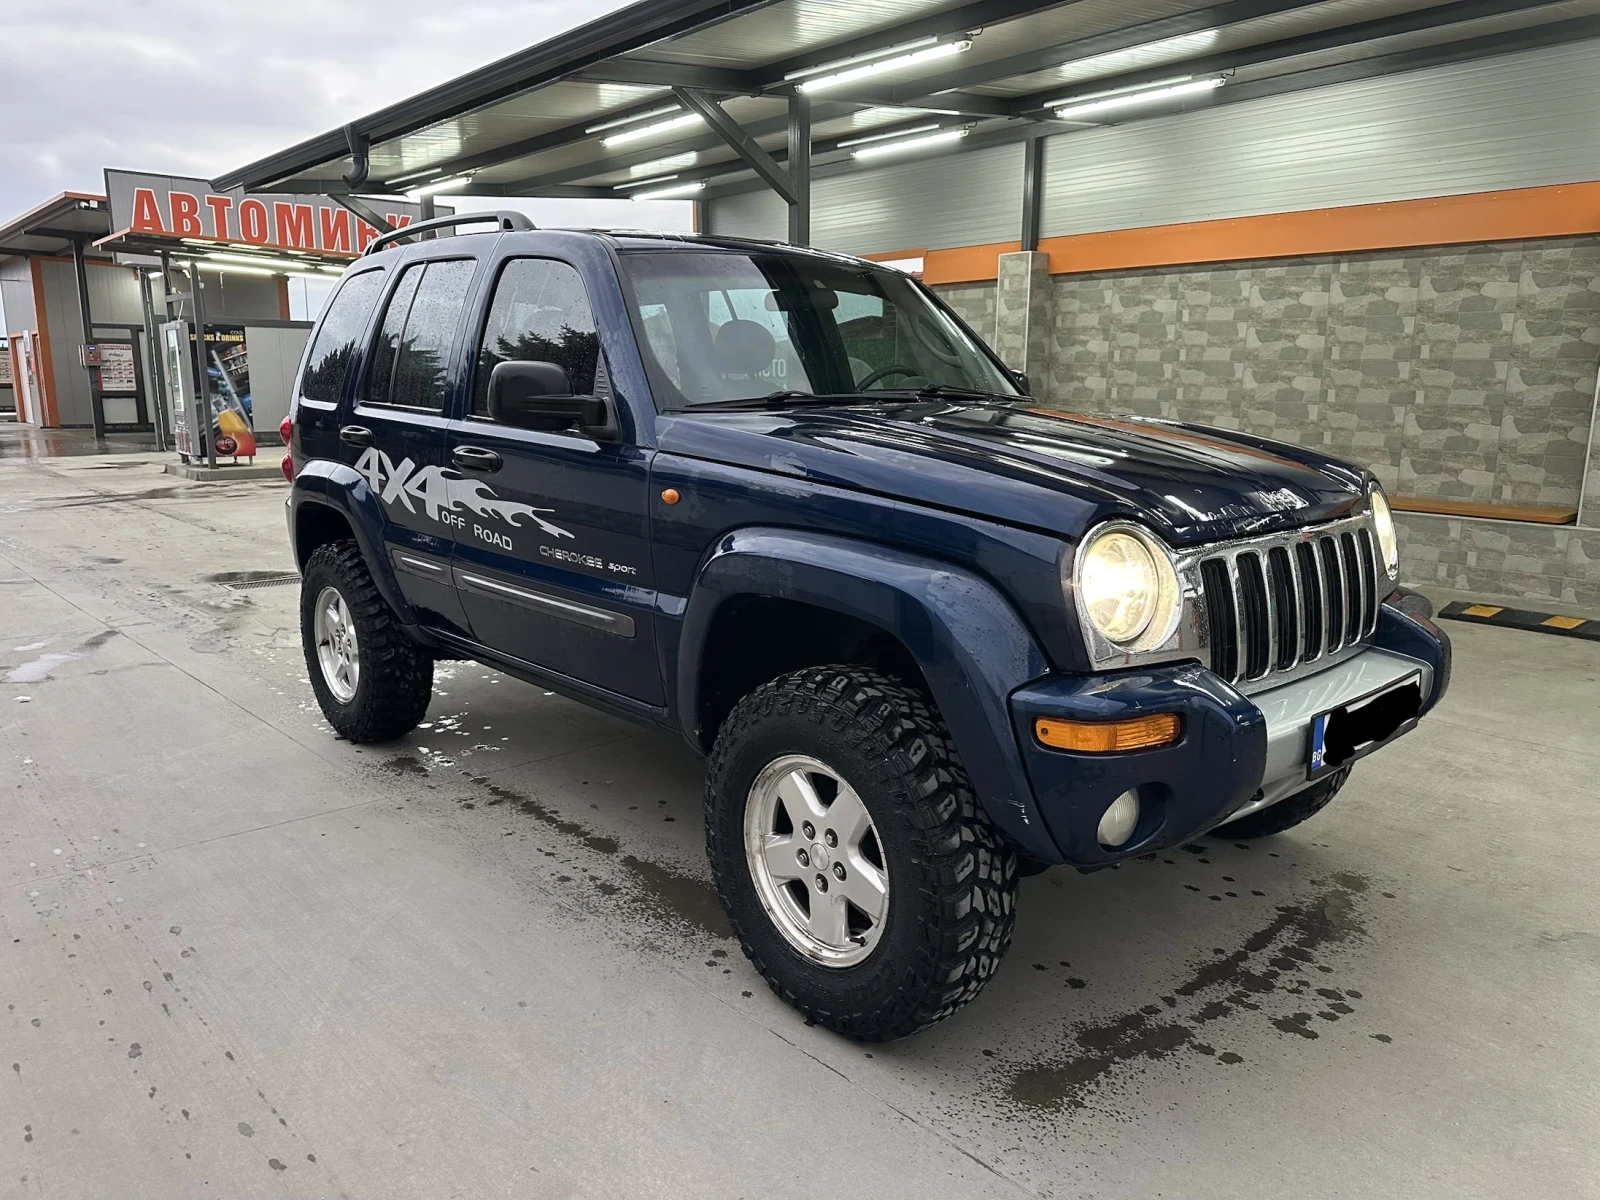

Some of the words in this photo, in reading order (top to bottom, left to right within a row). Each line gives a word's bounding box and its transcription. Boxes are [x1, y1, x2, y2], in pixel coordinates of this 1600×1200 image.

[221, 334, 244, 342] DRINKS
[441, 510, 466, 530] OFF
[473, 523, 512, 551] ROAD
[539, 545, 603, 569] CHEROKEE
[1311, 749, 1321, 763] BG
